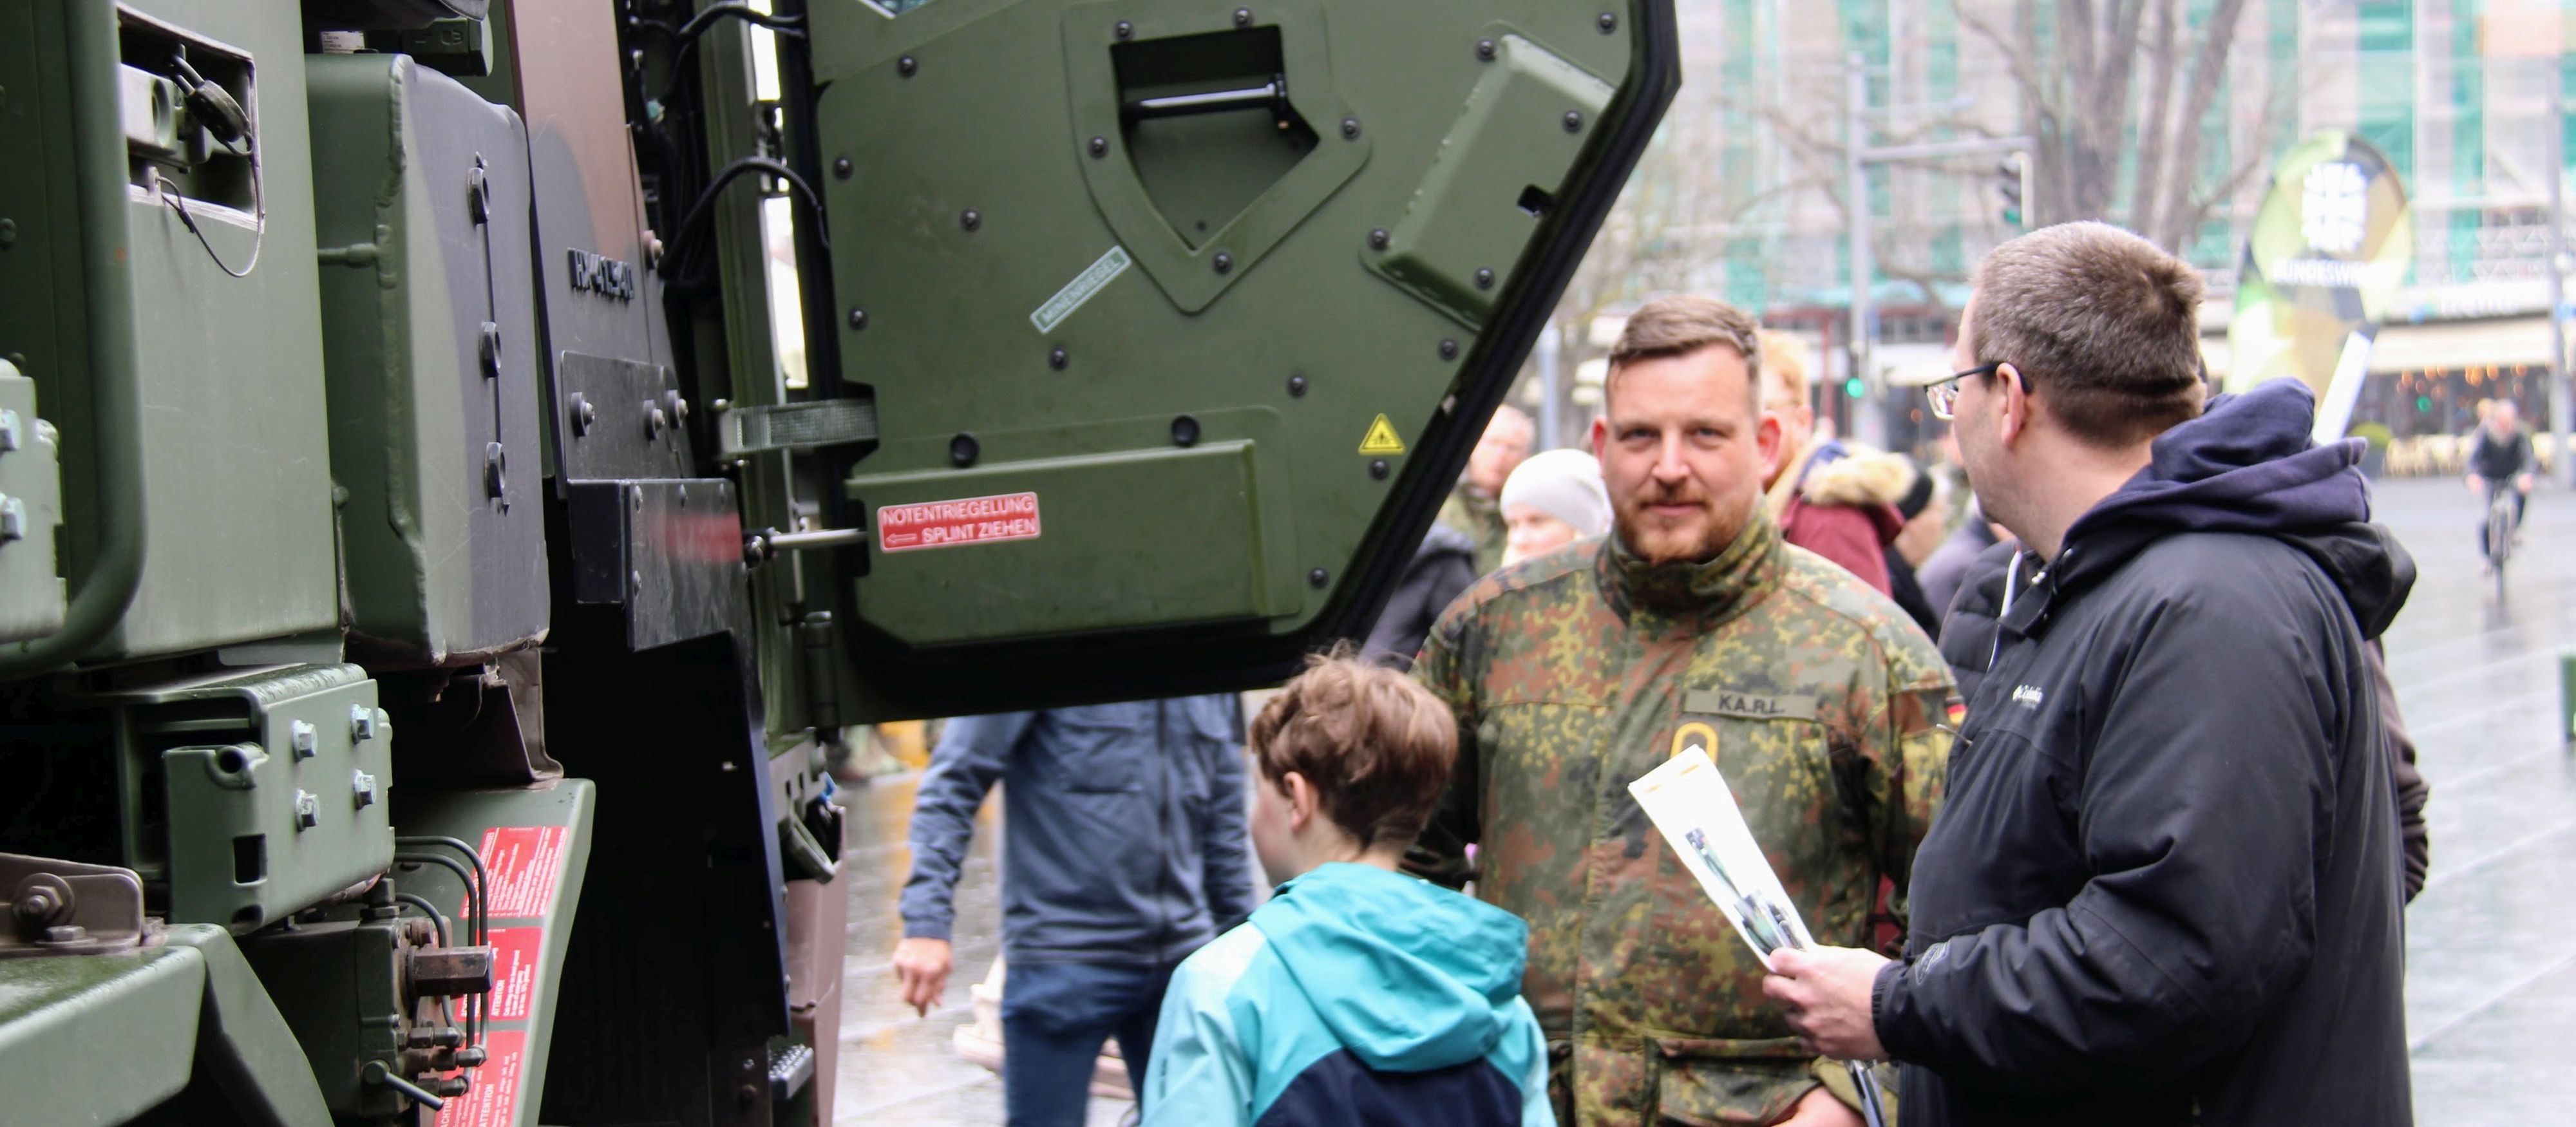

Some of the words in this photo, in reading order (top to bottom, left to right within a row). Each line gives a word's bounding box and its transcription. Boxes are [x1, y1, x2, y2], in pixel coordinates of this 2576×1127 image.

[1041, 258, 1121, 321] MINENRIEGEL
[882, 495, 1034, 526] NOTENTRIEGELUNG
[922, 523, 974, 544] SPLINT
[978, 518, 1036, 537] ZIEHEN
[491, 980, 505, 1016] ATTENTION
[440, 1097, 453, 1127] ACHTUN
[480, 1084, 495, 1127] ATTENTION
